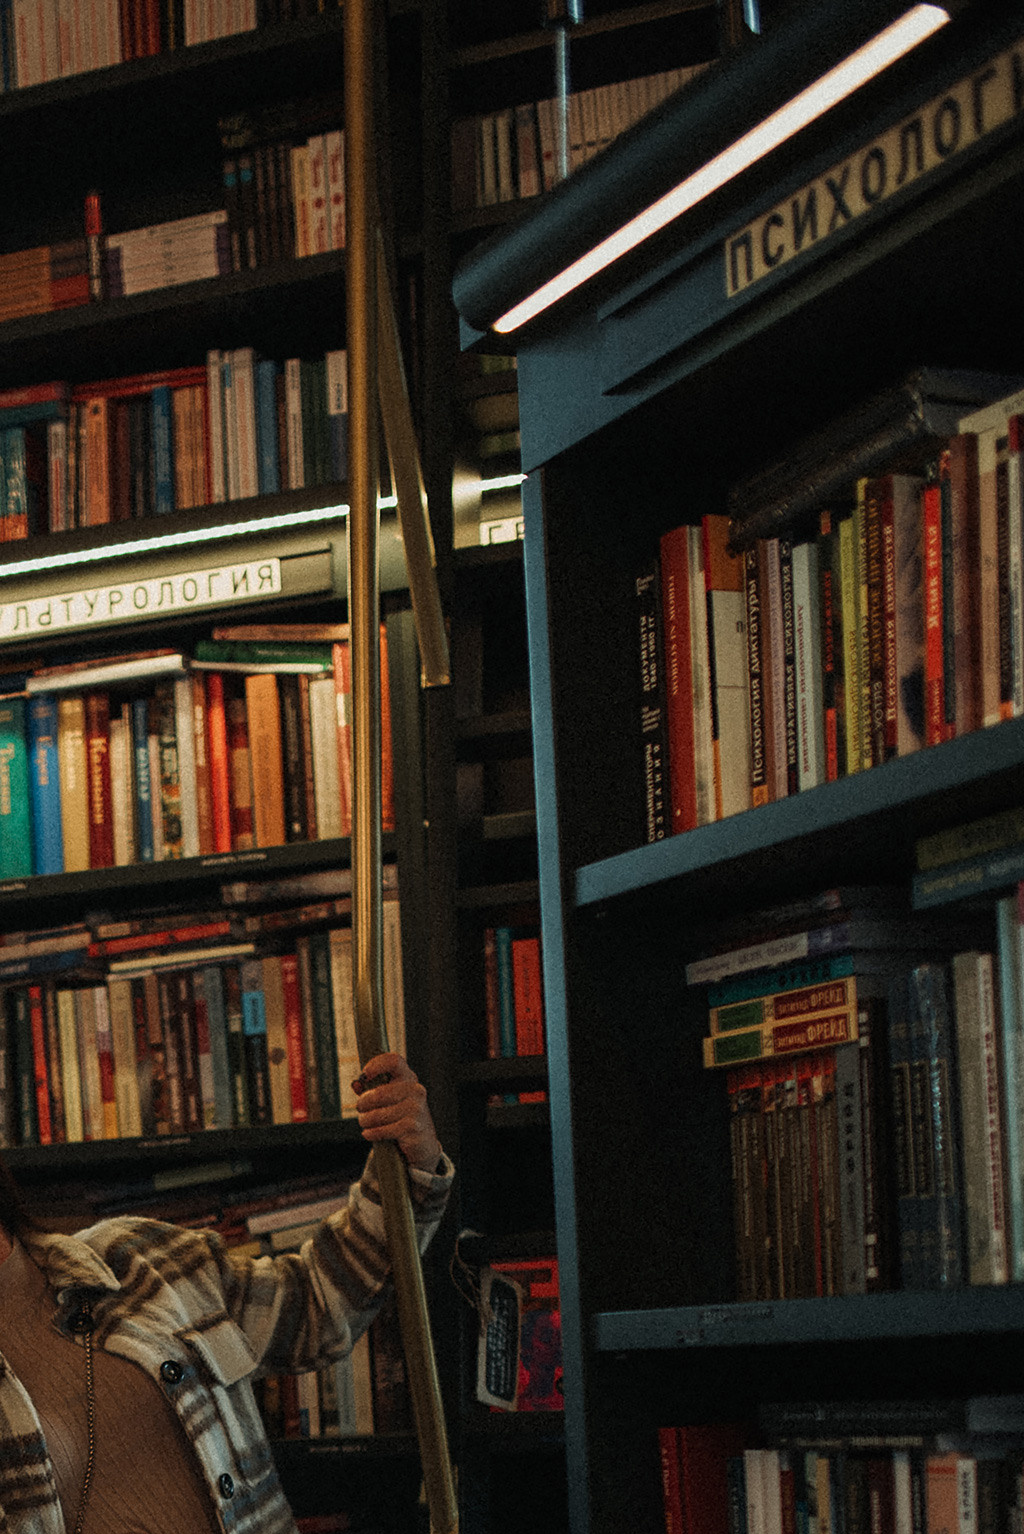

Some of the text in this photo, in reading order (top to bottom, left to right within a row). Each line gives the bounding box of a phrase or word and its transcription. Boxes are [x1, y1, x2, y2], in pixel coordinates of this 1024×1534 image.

[639, 614, 653, 693] ДОКУМЕНТЫ
[746, 579, 765, 783] Психология диктатуры
[781, 565, 797, 765] НАРРАТИВНАЯ ПСИХОЛОГИЯ
[806, 1018, 846, 1043] ФРЕЙД
[810, 986, 843, 1008] ФРЕЙД
